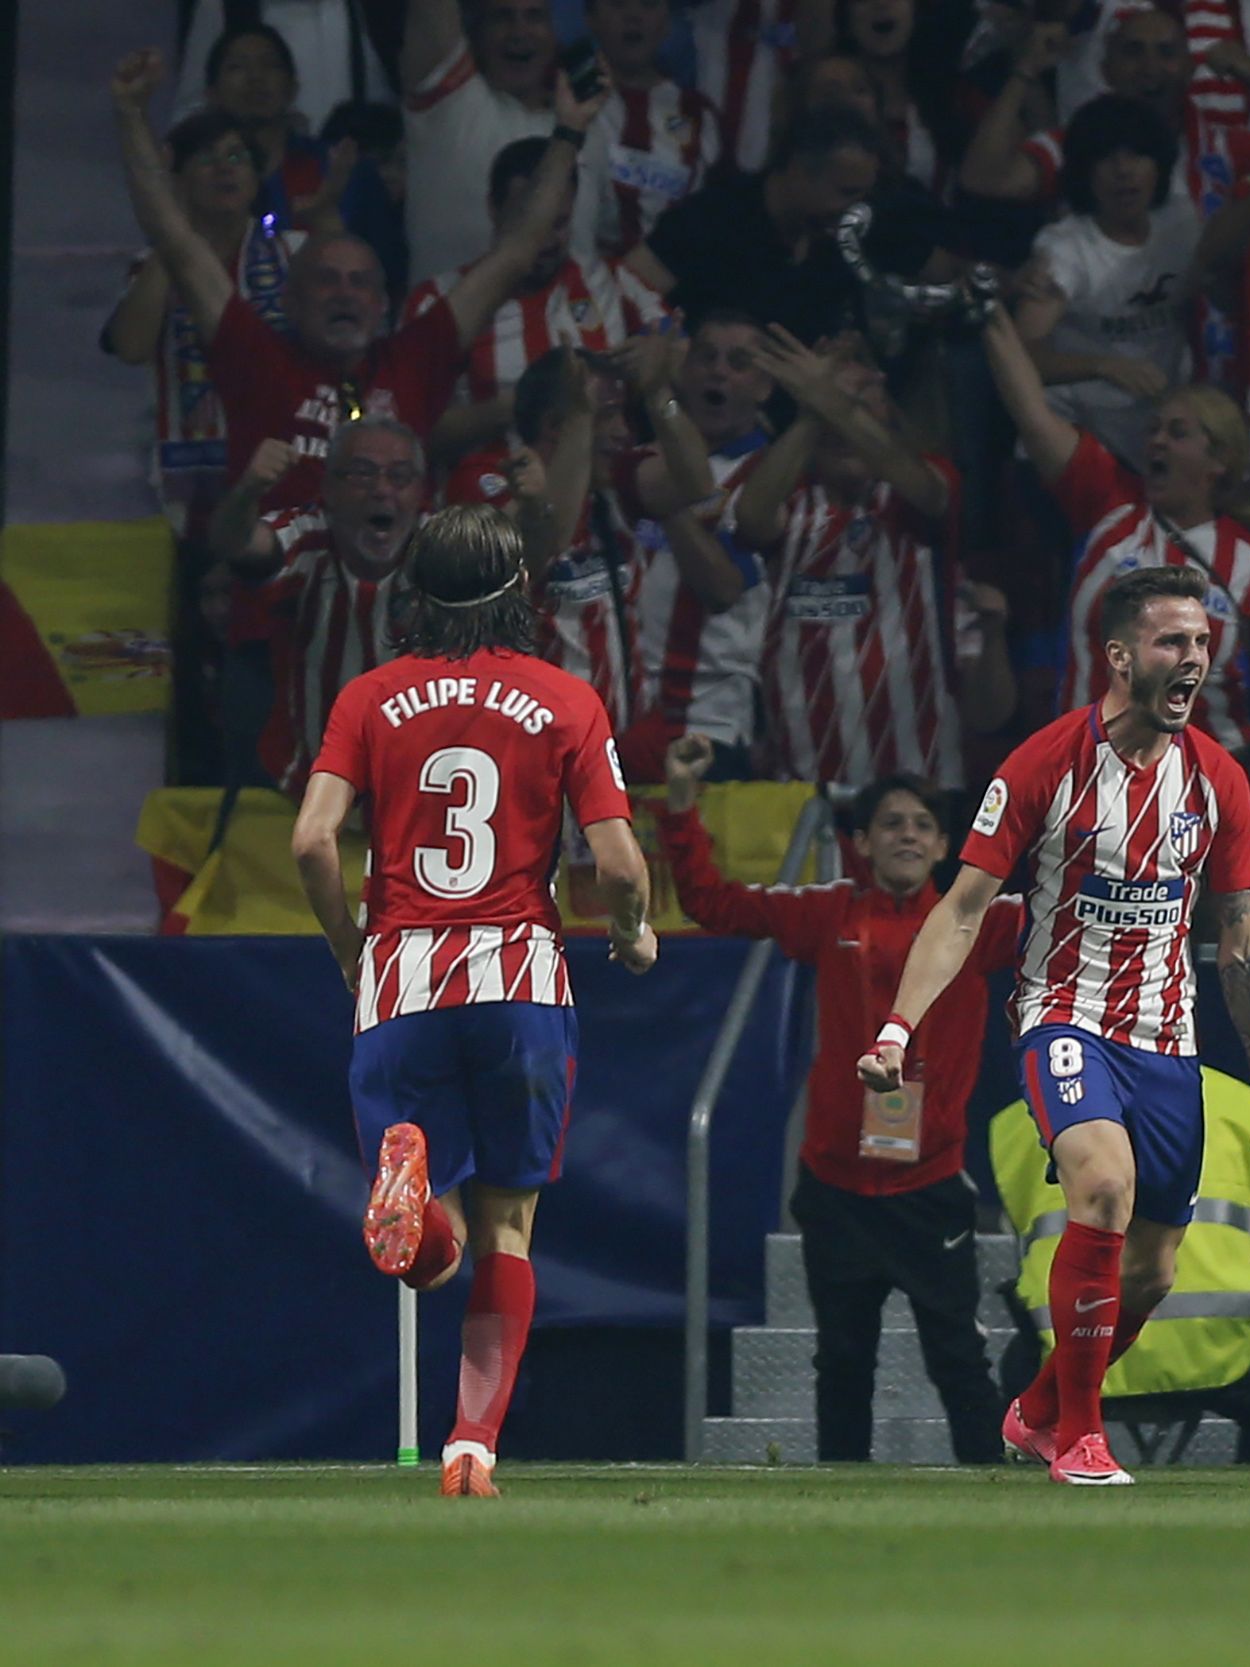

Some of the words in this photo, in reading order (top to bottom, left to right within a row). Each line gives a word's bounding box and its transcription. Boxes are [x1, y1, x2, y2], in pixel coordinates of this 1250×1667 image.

[380, 678, 477, 728] FILIPE
[484, 681, 554, 735] LUIS
[413, 746, 500, 900] 3
[1107, 881, 1169, 901] Trade
[1078, 901, 1180, 925] Plus500
[1049, 1037, 1083, 1077] 8
